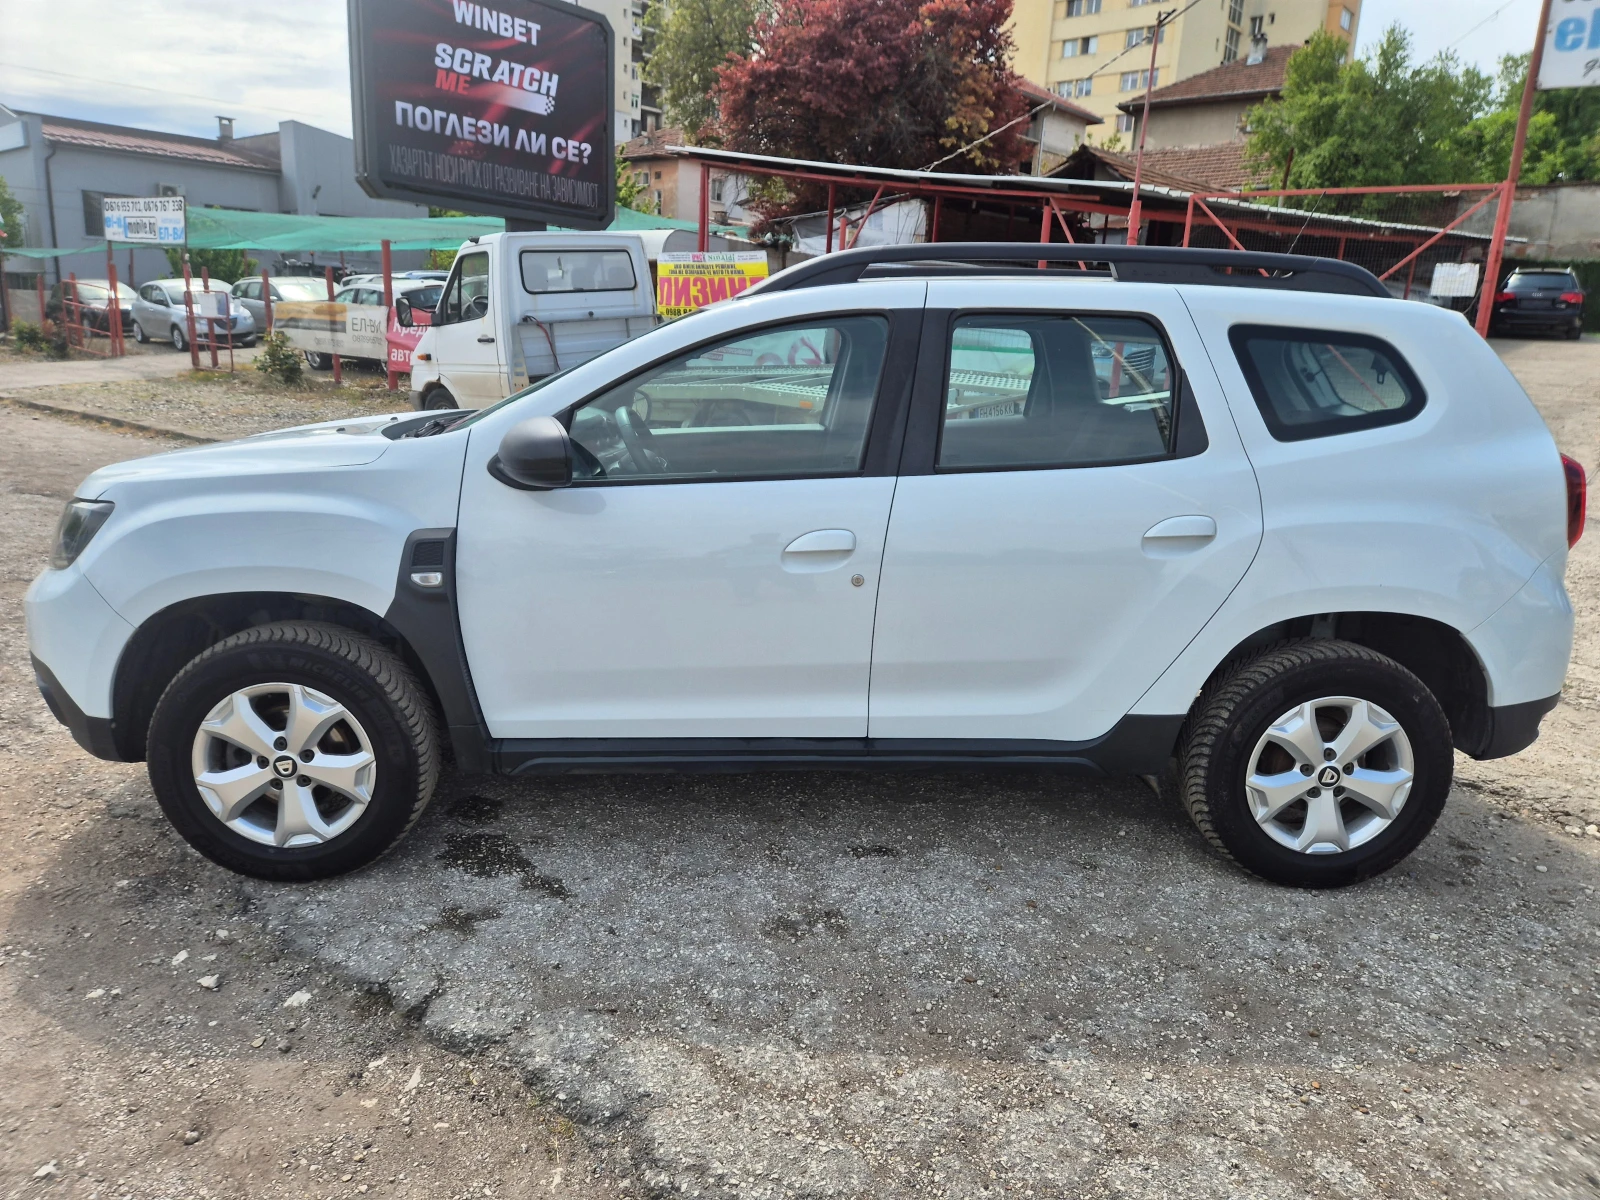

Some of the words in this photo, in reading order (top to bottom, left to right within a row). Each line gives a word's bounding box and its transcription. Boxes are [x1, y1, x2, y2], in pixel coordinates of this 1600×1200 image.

[452, 0, 541, 46] WINBET
[434, 42, 559, 97] SCRATCH
[435, 68, 472, 95] ME
[395, 100, 510, 148] ПОГЛЕЗИ
[514, 128, 547, 156] ЛИ
[551, 136, 592, 165] СЕ?
[435, 153, 459, 184] НОСИ
[459, 157, 482, 188] РИСК
[482, 162, 495, 189] ОТ
[495, 165, 540, 198] РАЗВИВАНЕ
[540, 173, 550, 200] НА
[551, 176, 599, 208] ЗАВИСИМОСТ
[127, 219, 157, 236] mobile.bg
[351, 317, 383, 334] ЕЛ-ВИ
[391, 348, 414, 362] авт
